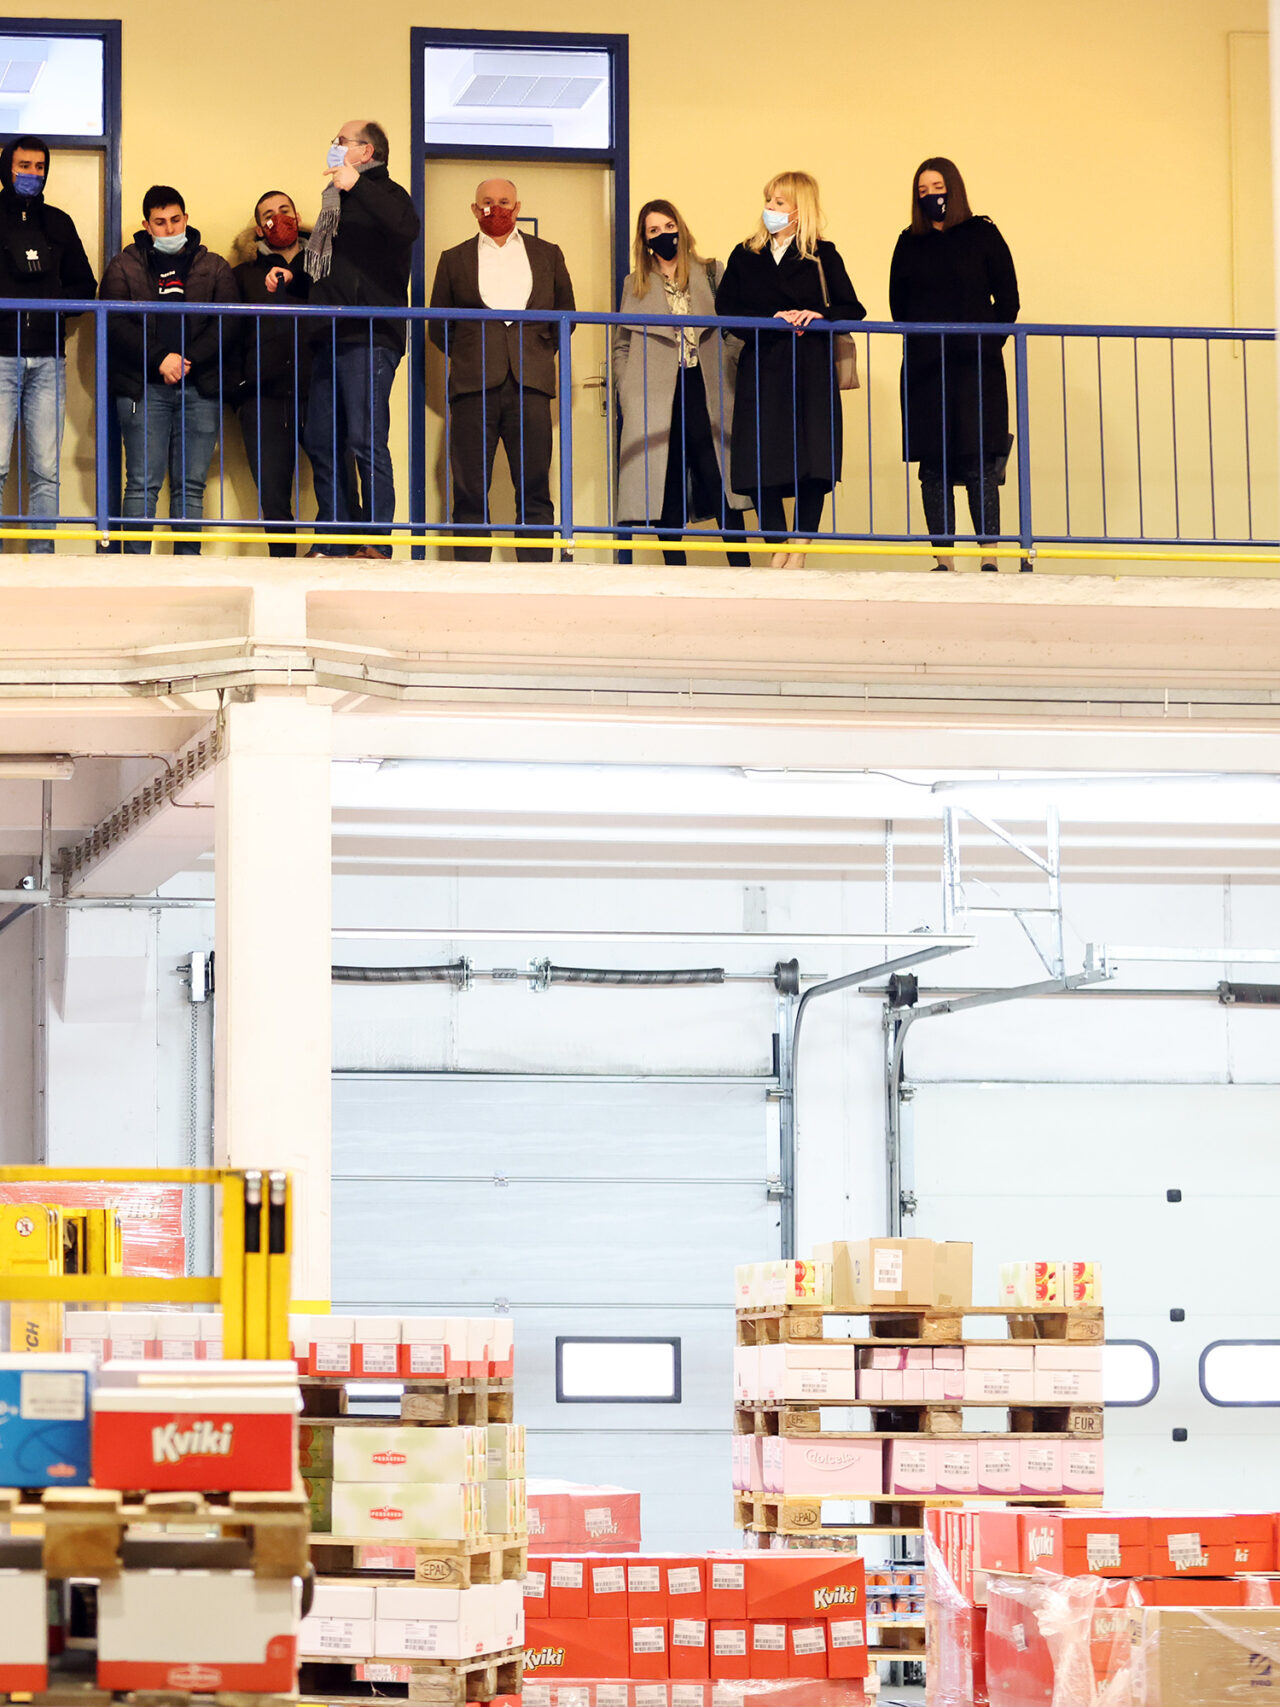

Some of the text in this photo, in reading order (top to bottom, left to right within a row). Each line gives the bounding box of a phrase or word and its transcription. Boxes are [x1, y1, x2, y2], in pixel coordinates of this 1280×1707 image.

[27, 1321, 40, 1353] CH
[1074, 1416, 1095, 1431] EUR
[152, 1420, 234, 1465] Kviki
[1028, 1527, 1054, 1562] Kviki
[424, 1562, 447, 1576] EPAL
[813, 1585, 857, 1610] Kviki
[522, 1648, 564, 1671] Kviki
